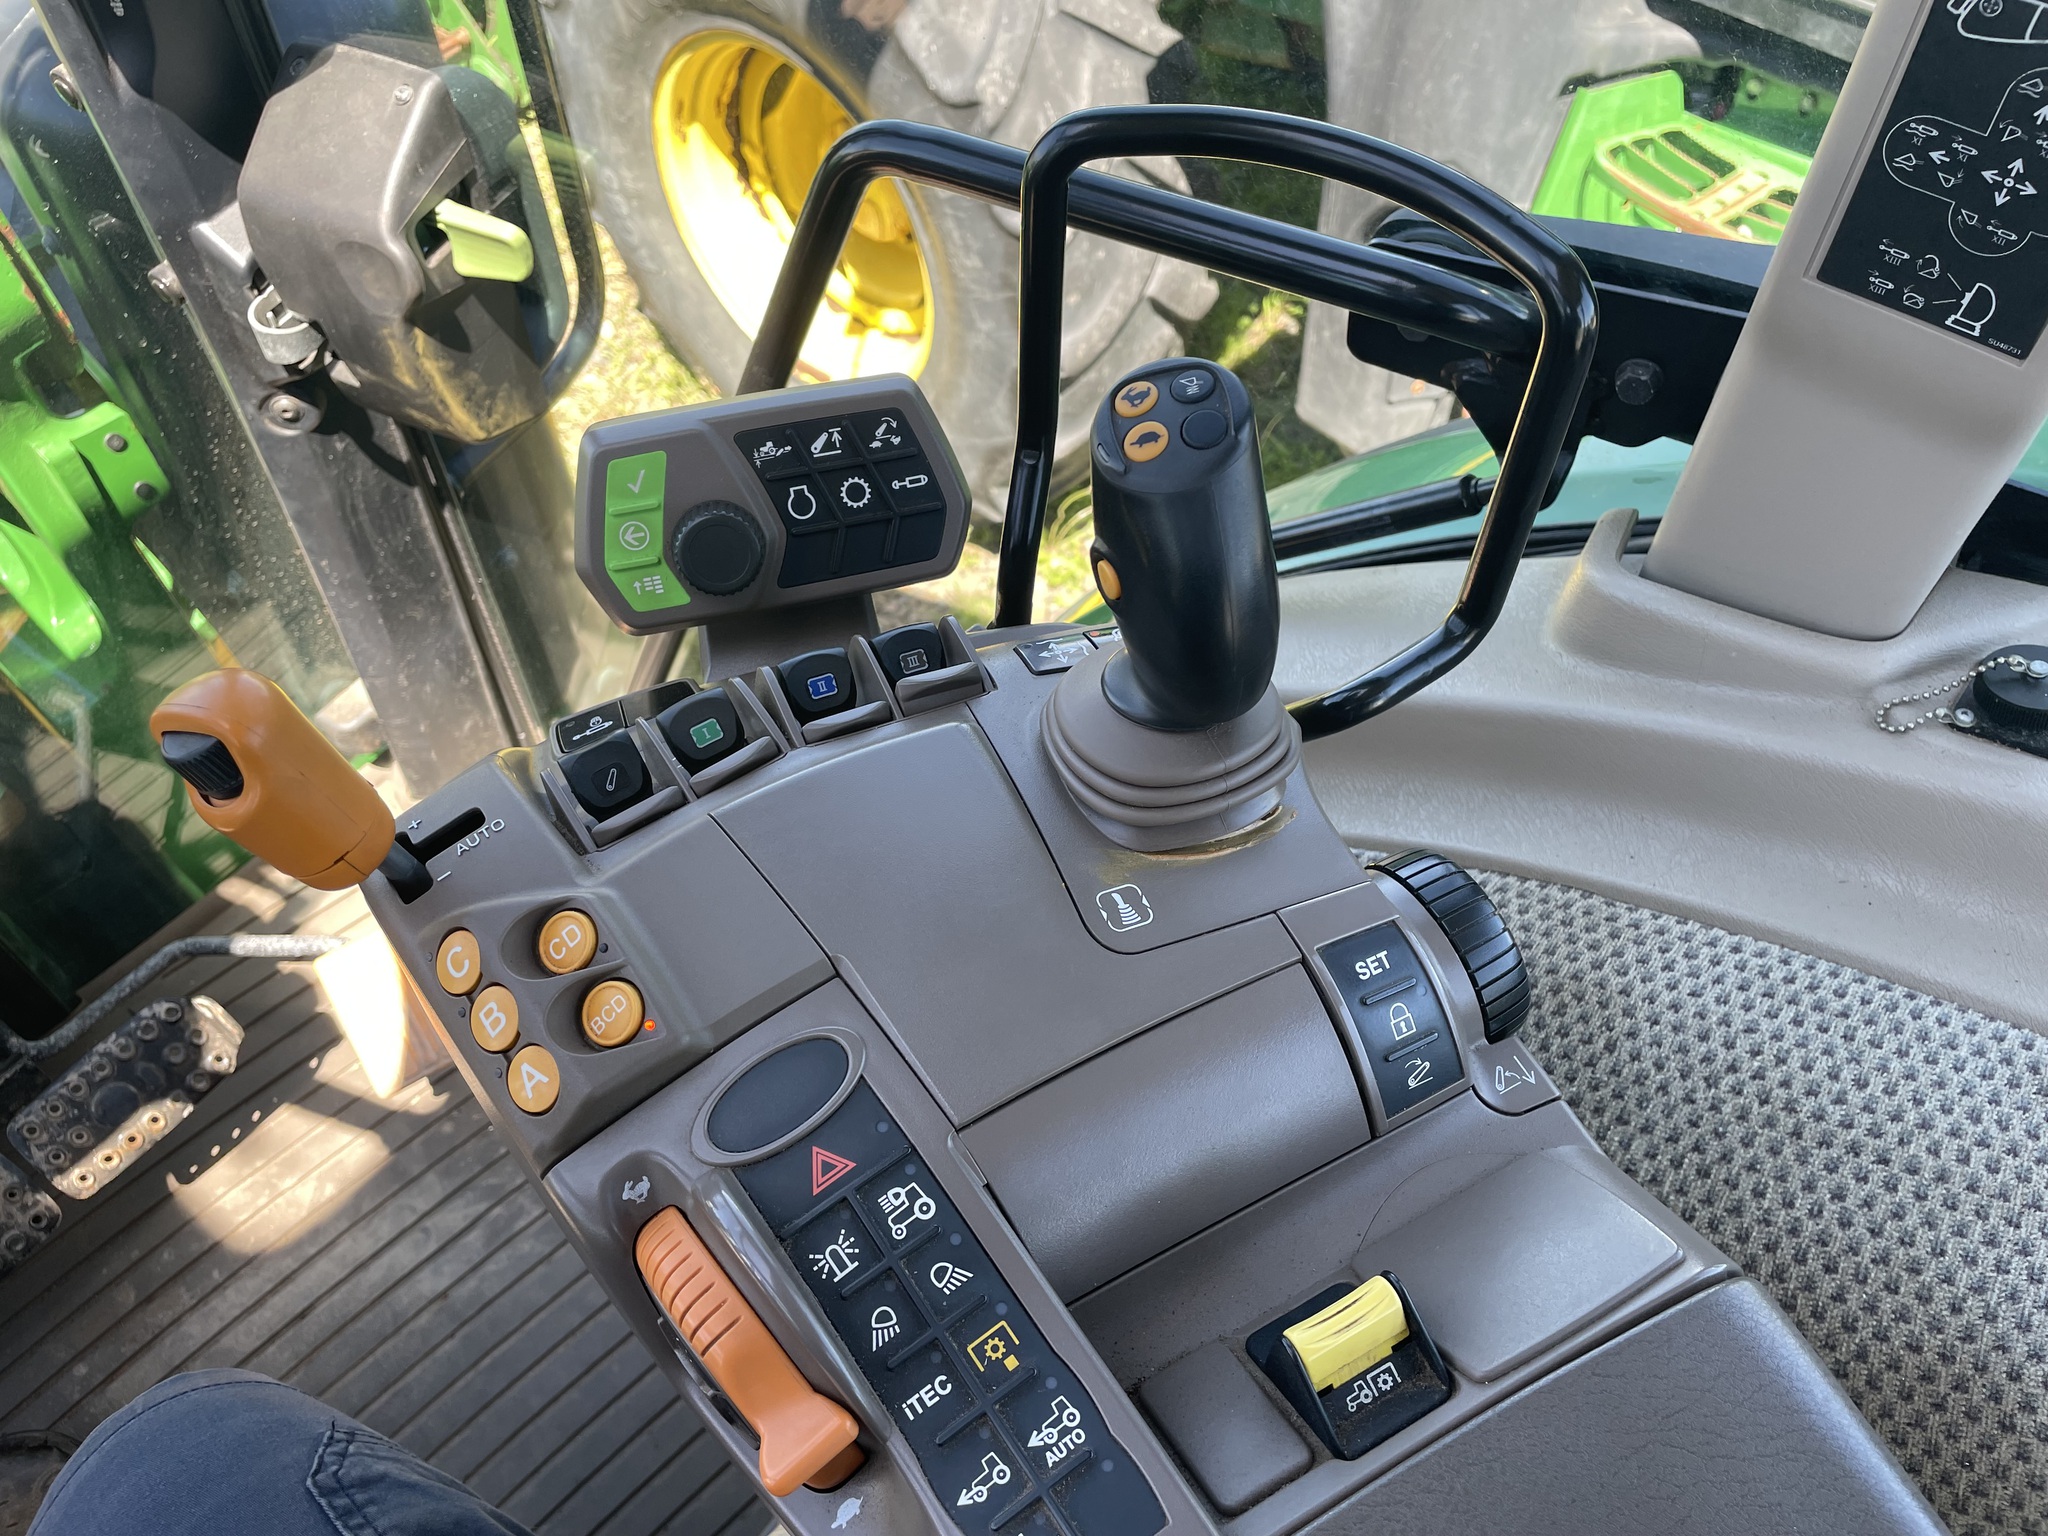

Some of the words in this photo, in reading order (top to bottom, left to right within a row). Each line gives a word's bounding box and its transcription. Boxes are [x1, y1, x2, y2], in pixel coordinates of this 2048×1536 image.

[1911, 136, 1923, 146] XI
[1956, 152, 1969, 163] XI
[1991, 235, 2007, 246] XII
[1883, 254, 1902, 266] XIII
[1868, 284, 1886, 296] XIII
[455, 818, 506, 856] AUTO
[549, 923, 582, 961] CD
[446, 945, 470, 978] C
[1355, 950, 1391, 980] SET
[478, 1000, 507, 1038] B
[590, 993, 628, 1036] BCD
[520, 1061, 549, 1100] A
[901, 1374, 953, 1421] iTEC
[1044, 1427, 1086, 1468] AUTO
